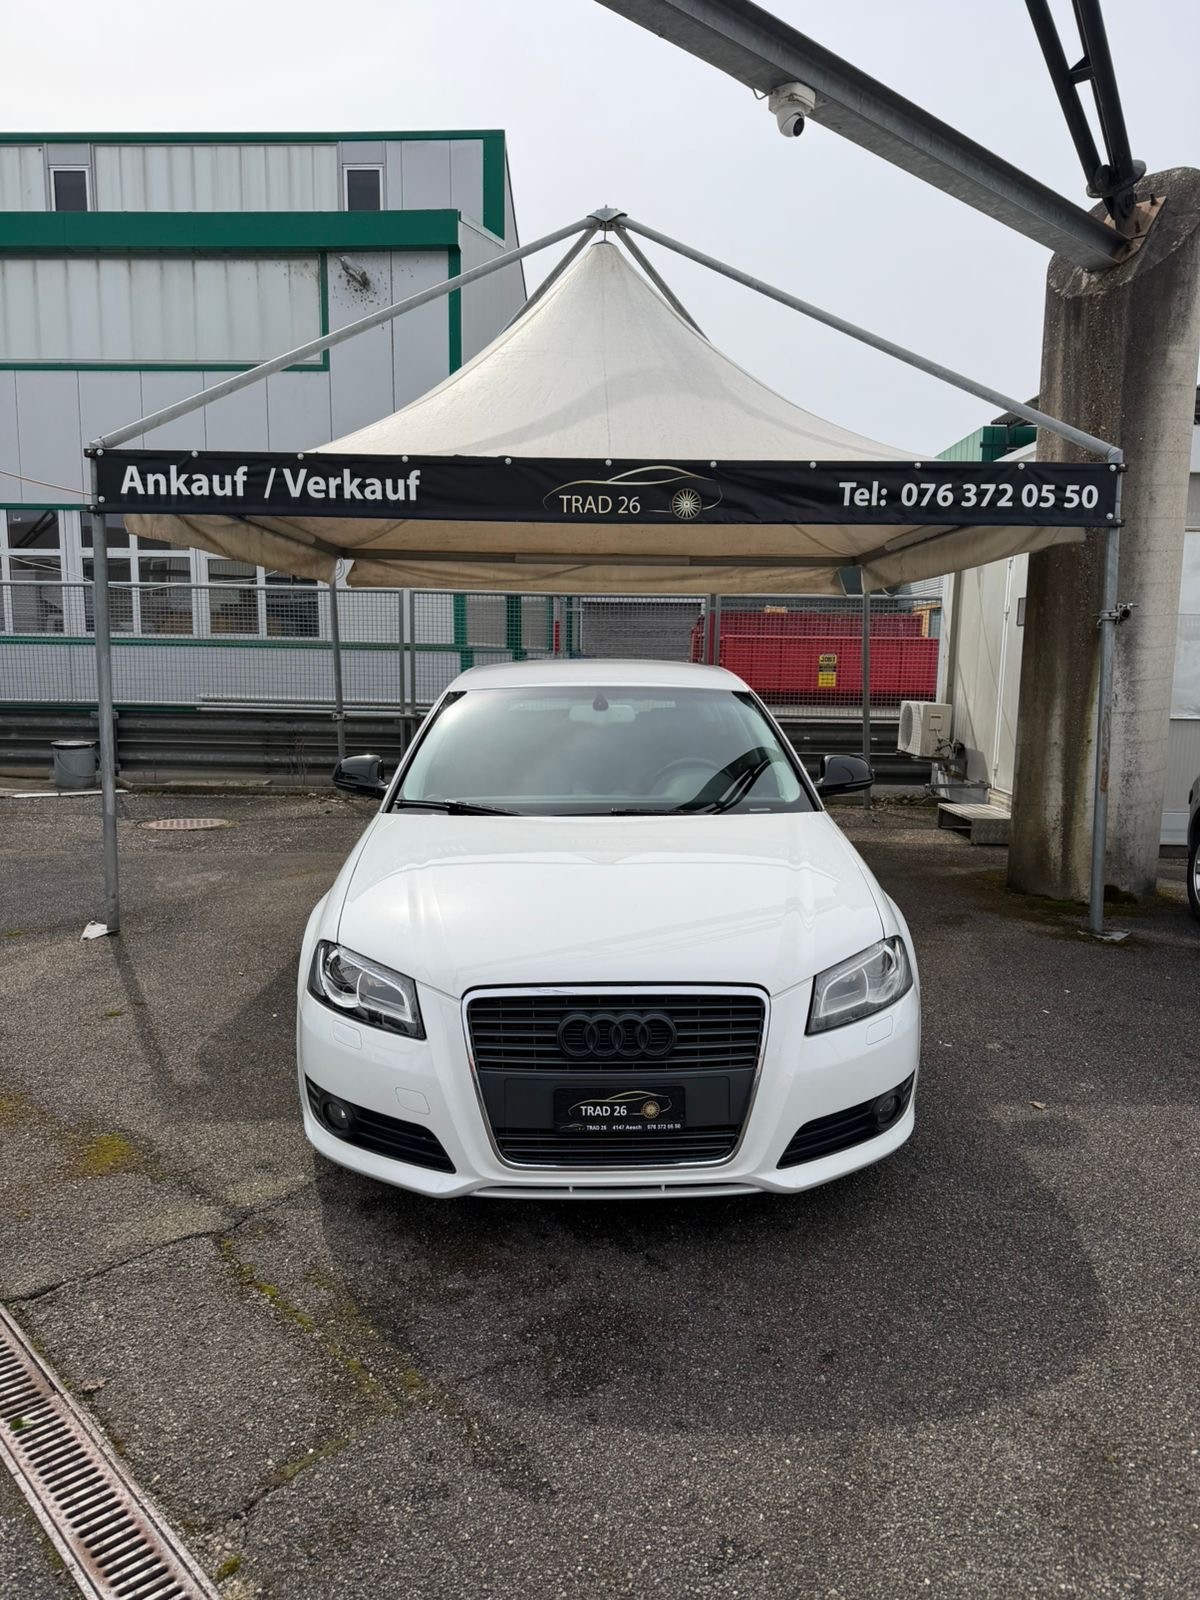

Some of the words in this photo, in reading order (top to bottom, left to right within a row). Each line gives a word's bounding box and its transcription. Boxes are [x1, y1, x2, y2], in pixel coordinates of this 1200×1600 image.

[120, 465, 248, 497] Ankauf
[559, 495, 613, 514] TRAD
[617, 496, 641, 514] 26
[839, 481, 888, 507] Tel:
[901, 483, 954, 507] 076
[960, 483, 1014, 508] 372
[1021, 484, 1056, 508] 05
[1063, 485, 1099, 509] 50
[580, 1106, 611, 1116] TRAD
[613, 1105, 627, 1116] 26
